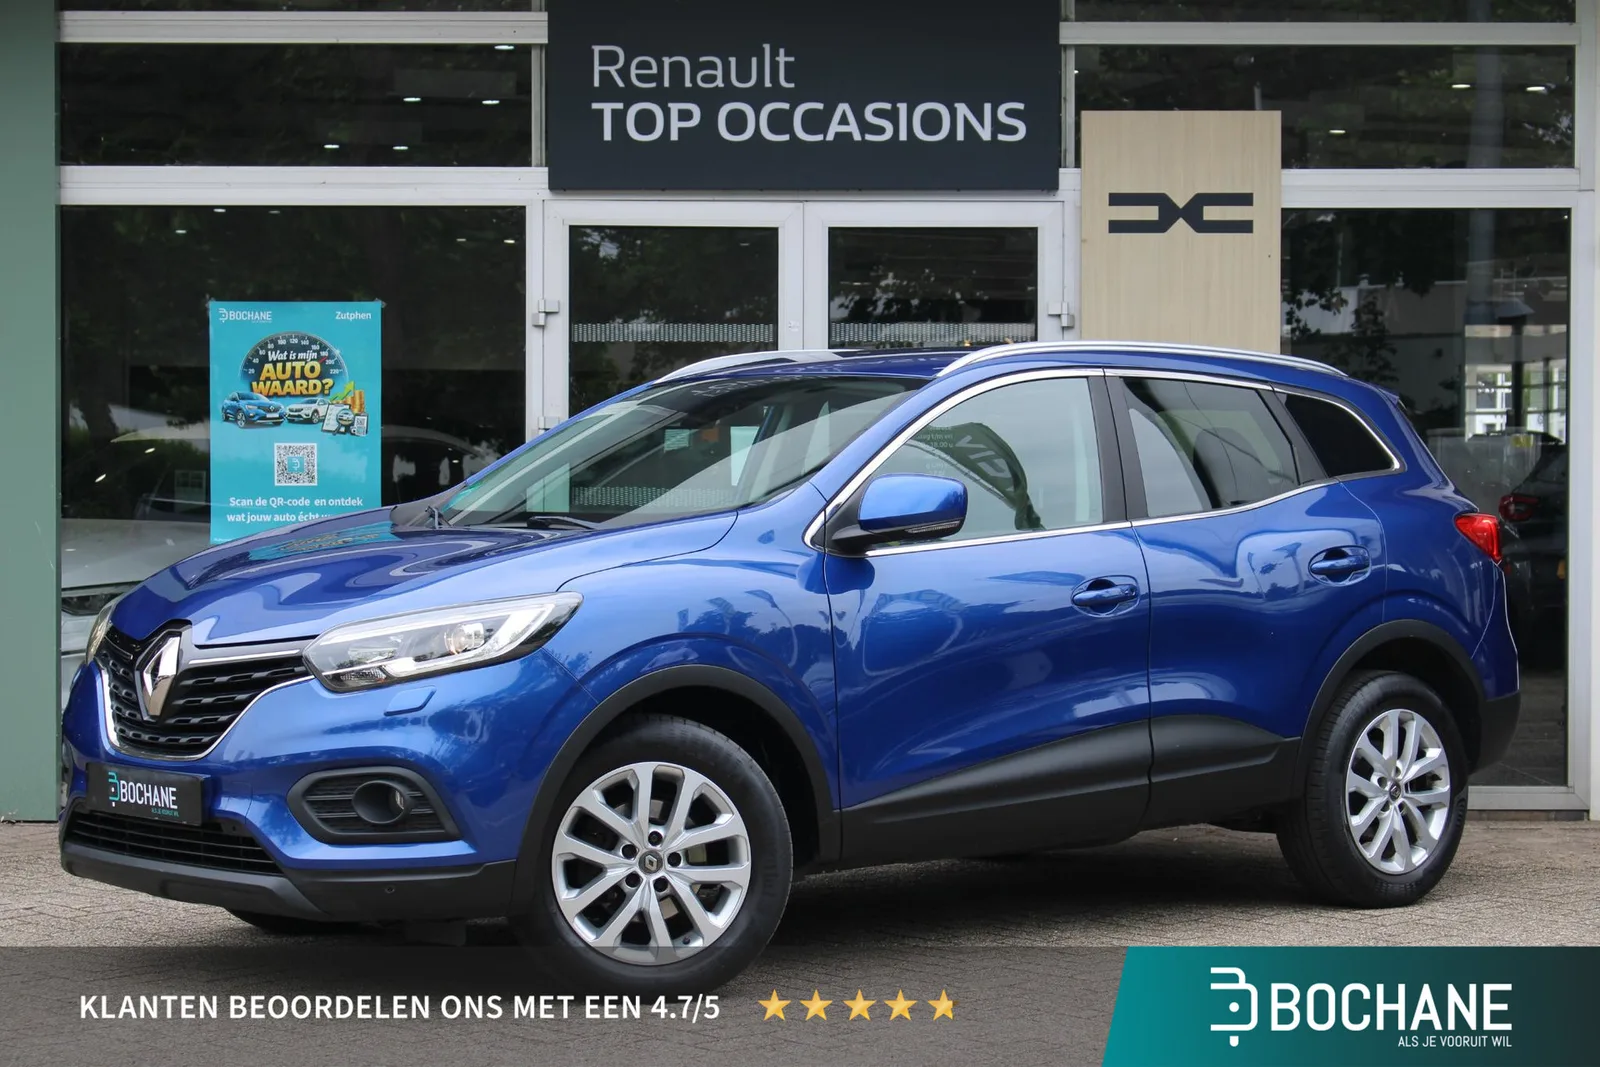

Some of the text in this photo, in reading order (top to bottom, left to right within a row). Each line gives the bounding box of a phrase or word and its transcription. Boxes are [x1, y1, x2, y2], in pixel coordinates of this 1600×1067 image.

[592, 44, 795, 88] Renault
[592, 101, 1027, 142] TOP OCCASIONS
[229, 310, 272, 321] BOCHANE
[335, 310, 372, 322] Zutphen
[268, 350, 318, 362] Wat is mijn
[260, 361, 321, 381] AUTO
[251, 378, 334, 396] WAARD?
[229, 497, 363, 508] Scan de QR-code en ontdek
[226, 513, 246, 522] wat
[246, 512, 272, 524] jouw
[273, 513, 297, 522] auto
[120, 780, 178, 809] BOCHANE
